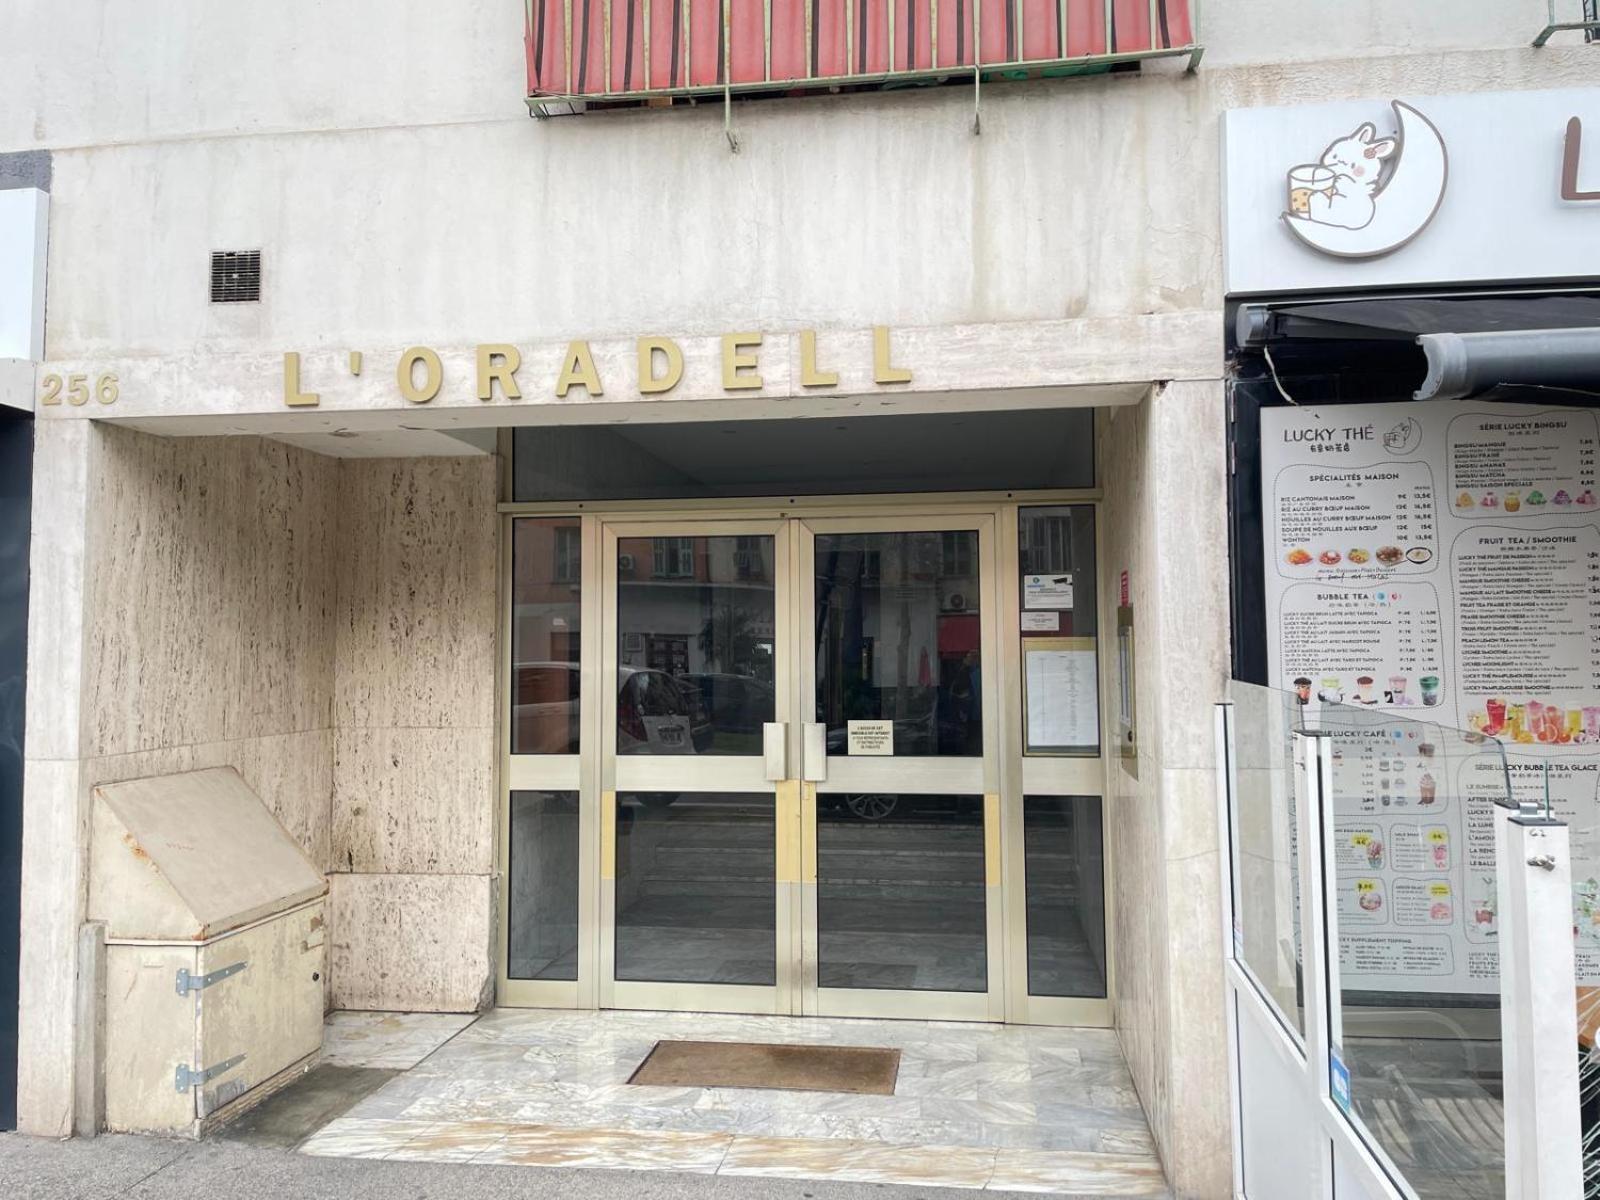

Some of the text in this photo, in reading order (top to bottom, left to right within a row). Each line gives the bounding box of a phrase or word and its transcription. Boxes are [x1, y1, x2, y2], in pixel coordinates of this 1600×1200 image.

[284, 326, 911, 406] L'ORADELL
[42, 372, 120, 407] 256
[1284, 424, 1374, 442] LUCKY THÉ
[1309, 472, 1361, 482] SPÉCIALITÉS
[1363, 729, 1386, 737] CAFÉ
